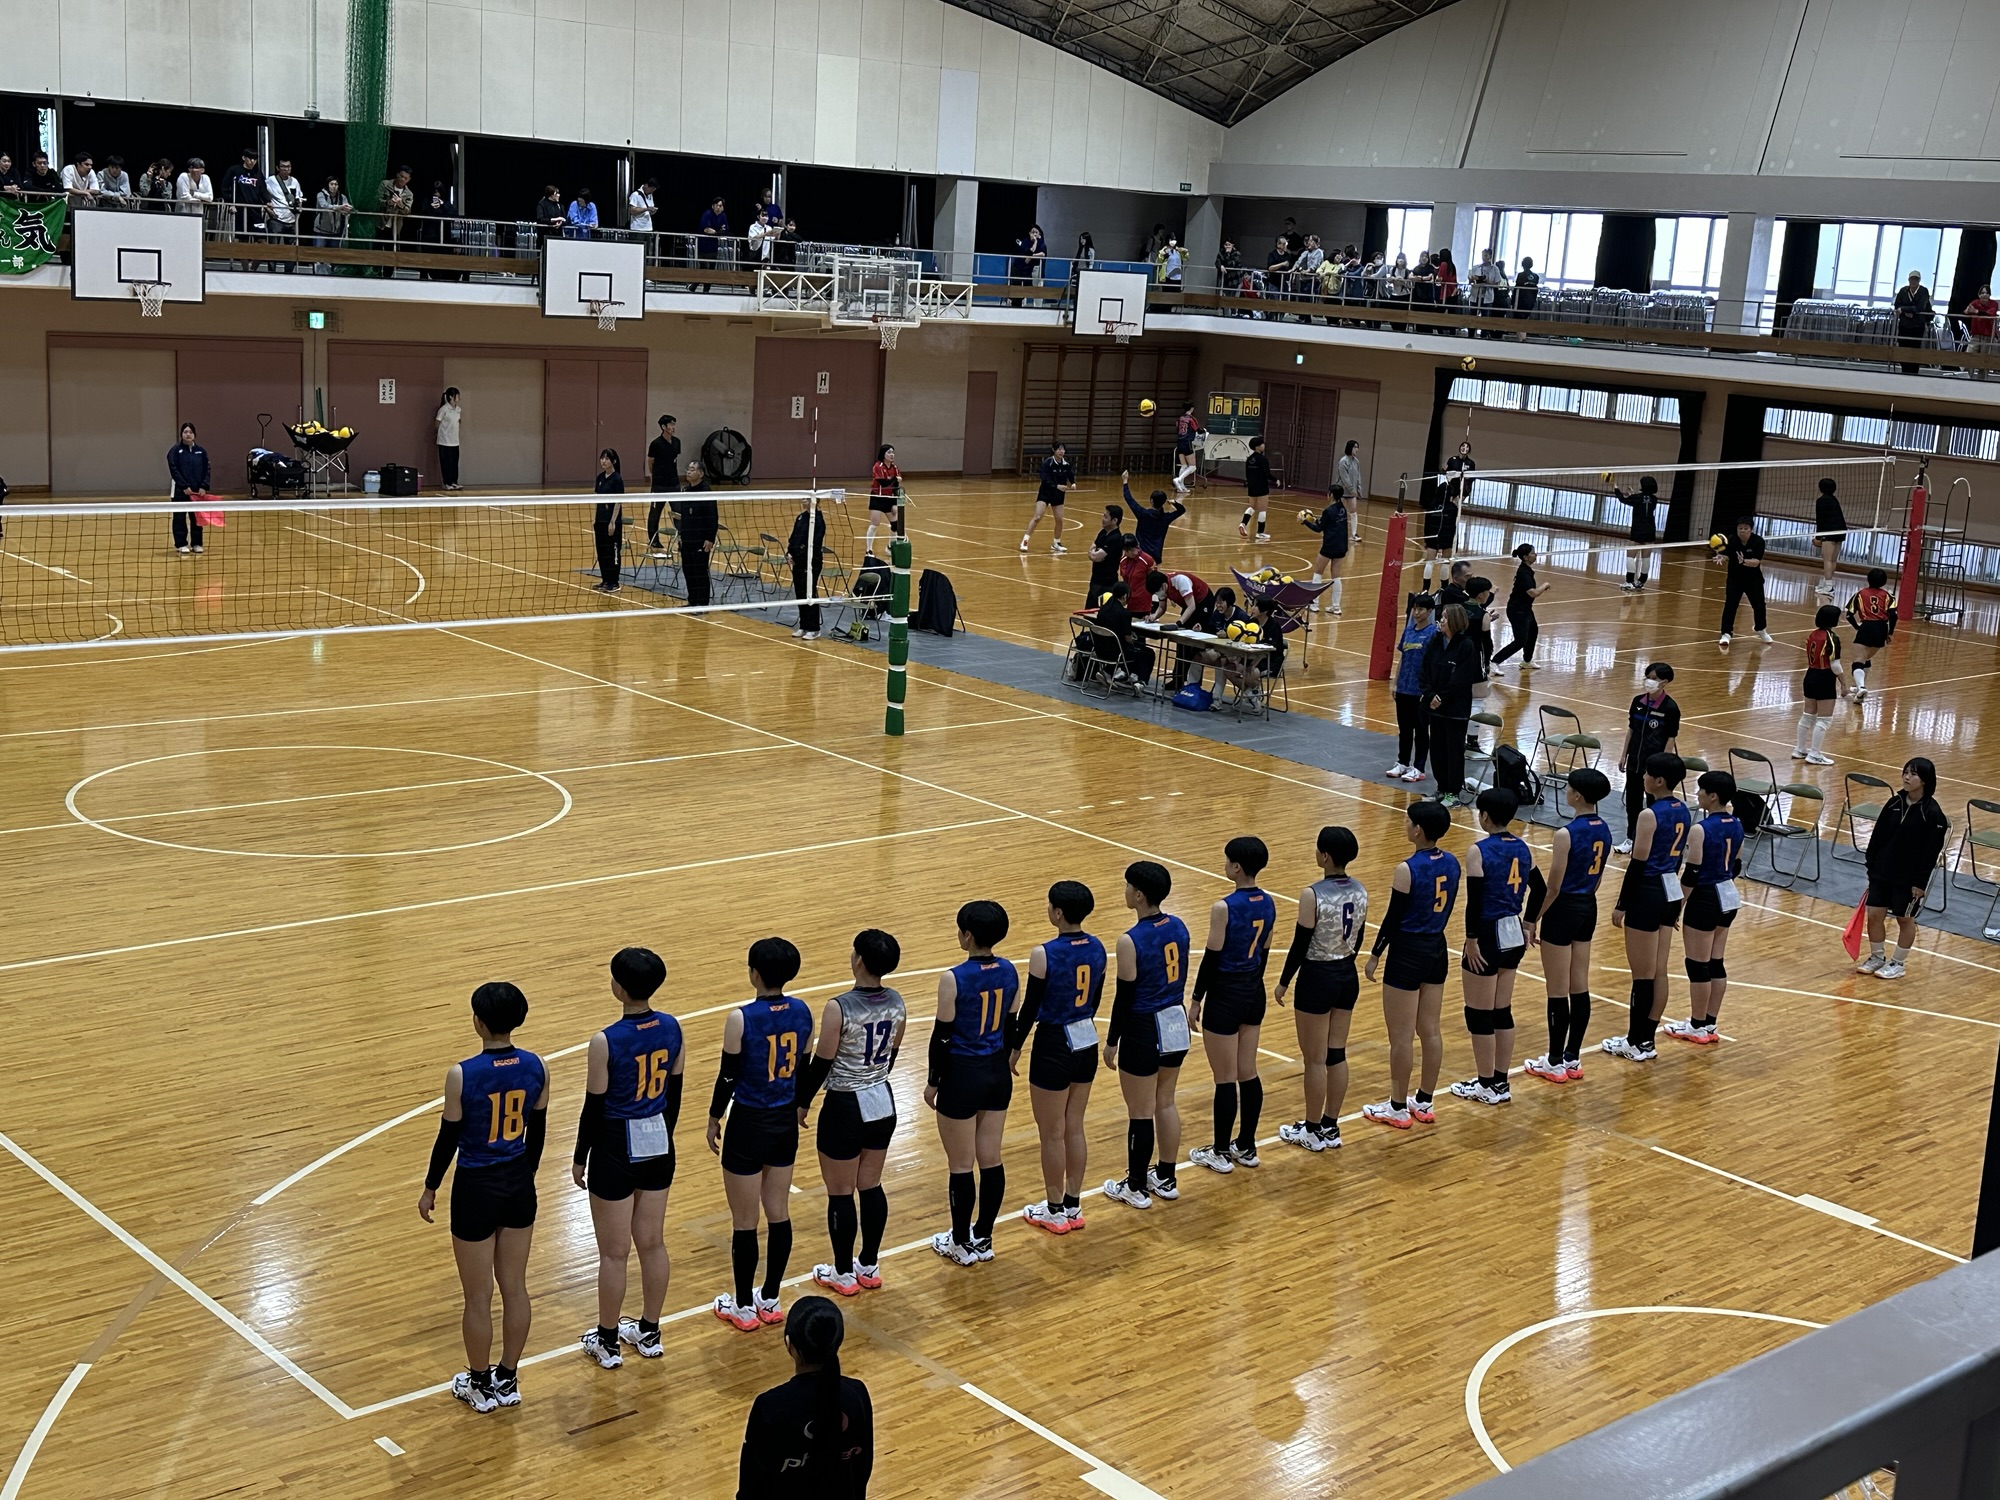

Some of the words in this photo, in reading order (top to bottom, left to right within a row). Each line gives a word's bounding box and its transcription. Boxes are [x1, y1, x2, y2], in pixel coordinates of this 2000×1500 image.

[820, 373, 827, 386] H
[1869, 595, 1879, 615] 3
[1587, 840, 1604, 876] 3
[1669, 822, 1685, 857] 2
[1724, 838, 1732, 872] 1
[1433, 875, 1448, 913] 5
[1506, 857, 1522, 895] 4
[1247, 919, 1265, 960] 7
[1342, 902, 1354, 941] 6
[1163, 941, 1180, 985] 8
[1075, 964, 1091, 1009] 9
[978, 987, 1004, 1037] 11
[766, 1031, 798, 1083] 13
[862, 1019, 893, 1067] 12
[634, 1048, 669, 1103] 16
[487, 1088, 527, 1145] 18
